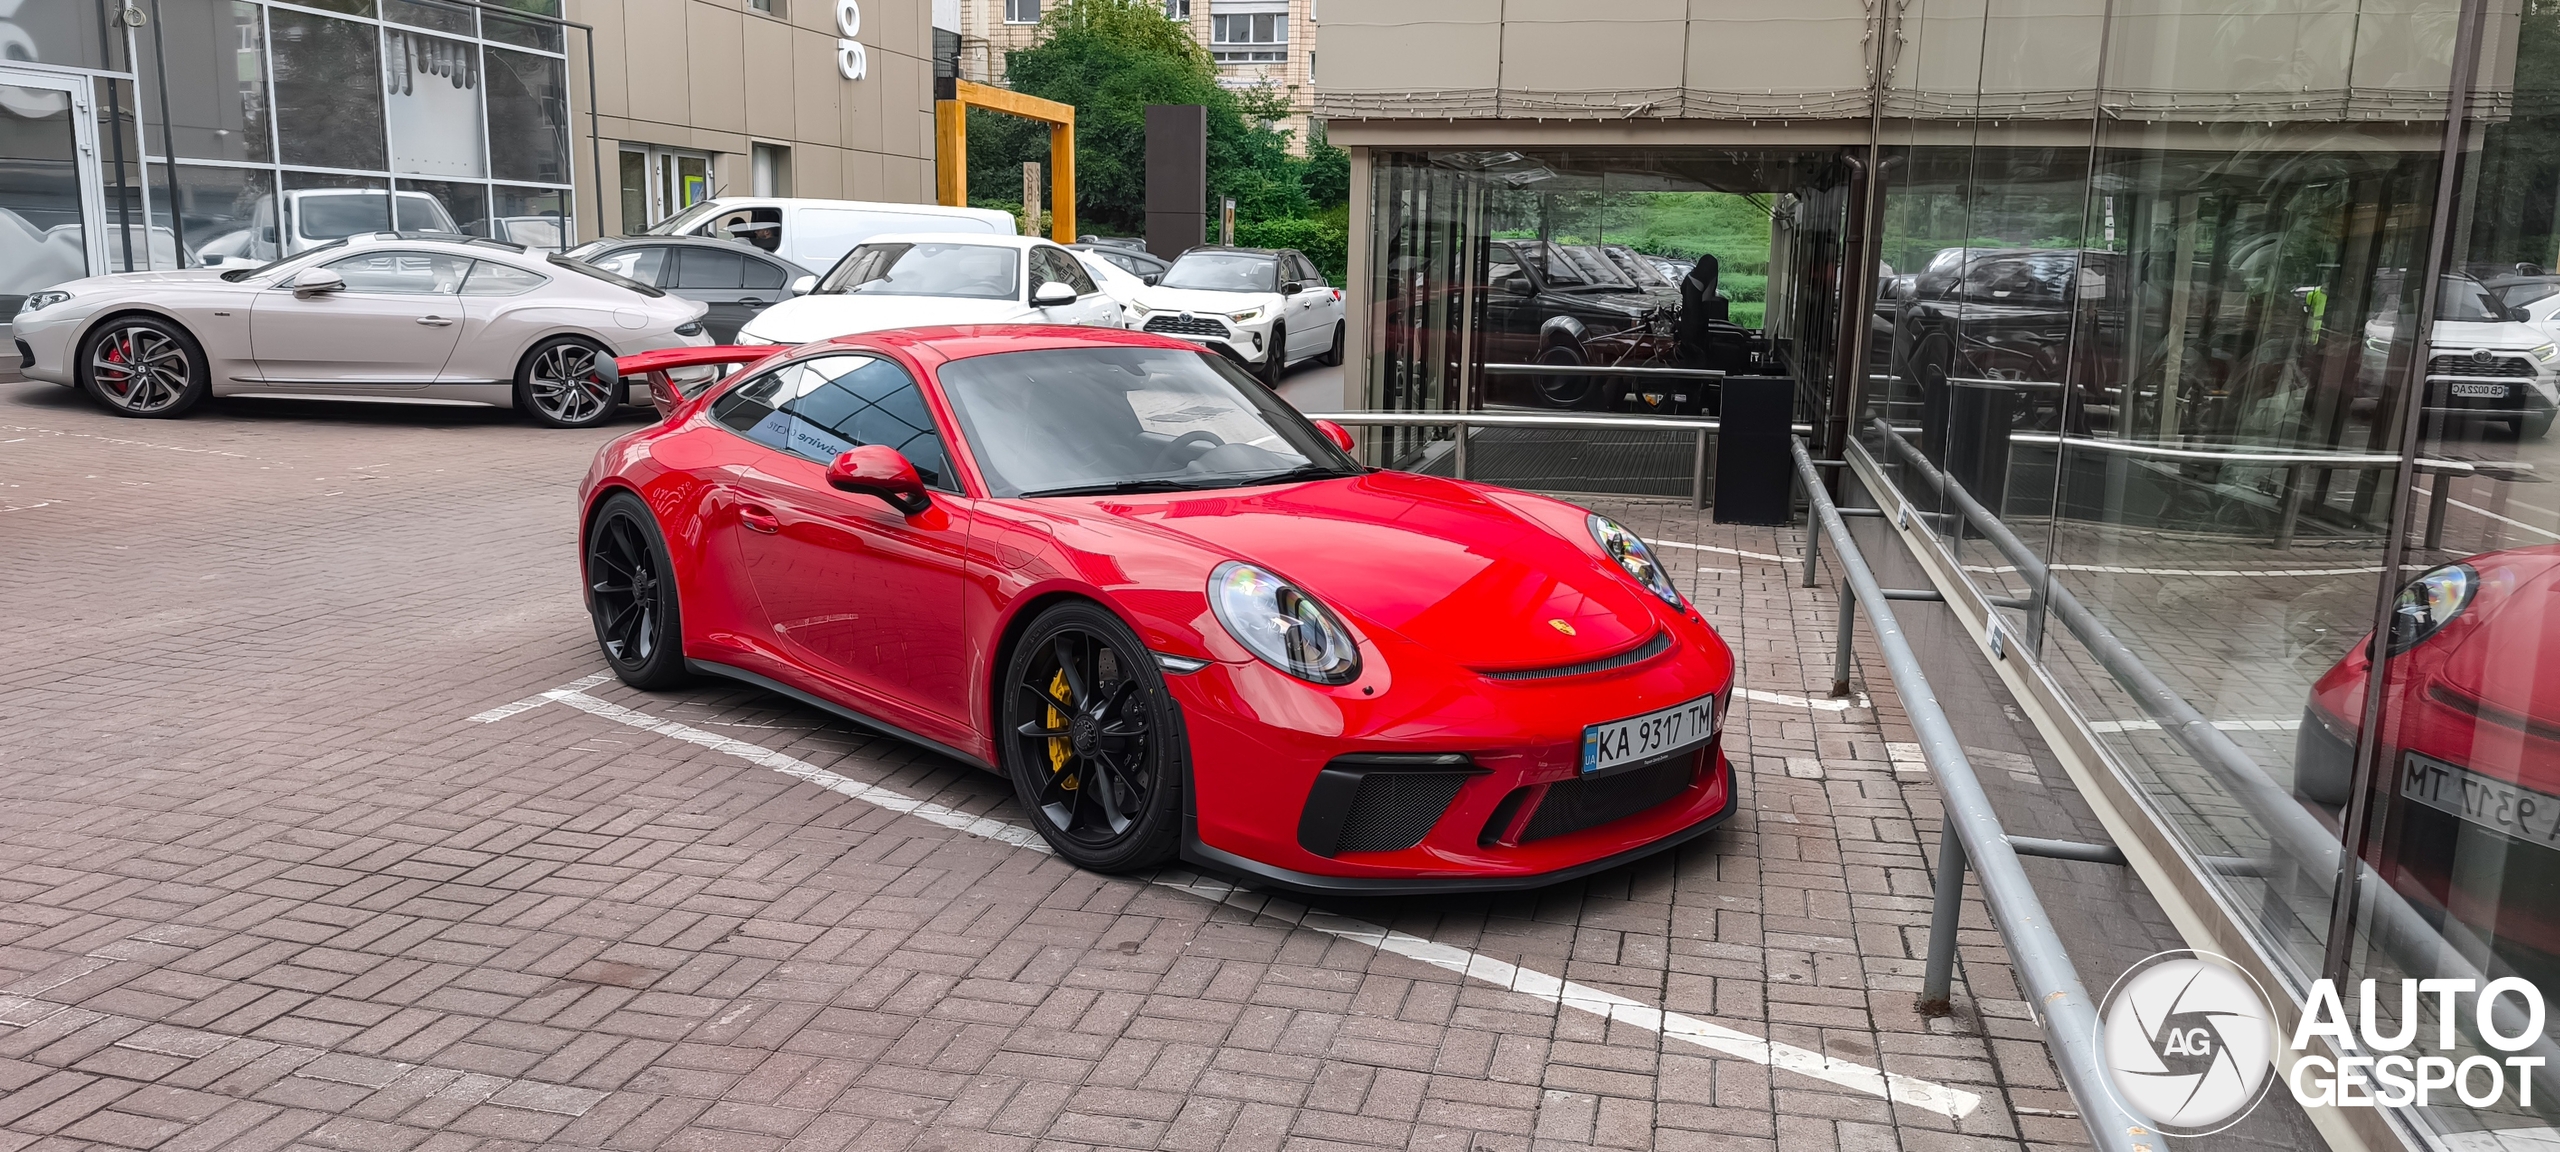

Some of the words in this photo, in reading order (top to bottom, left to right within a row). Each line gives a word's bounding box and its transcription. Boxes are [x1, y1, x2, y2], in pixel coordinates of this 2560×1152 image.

[1598, 727, 1631, 763] KA
[1639, 711, 1682, 754] 9317
[1689, 701, 1711, 737] TM
[1585, 754, 1596, 766] UA
